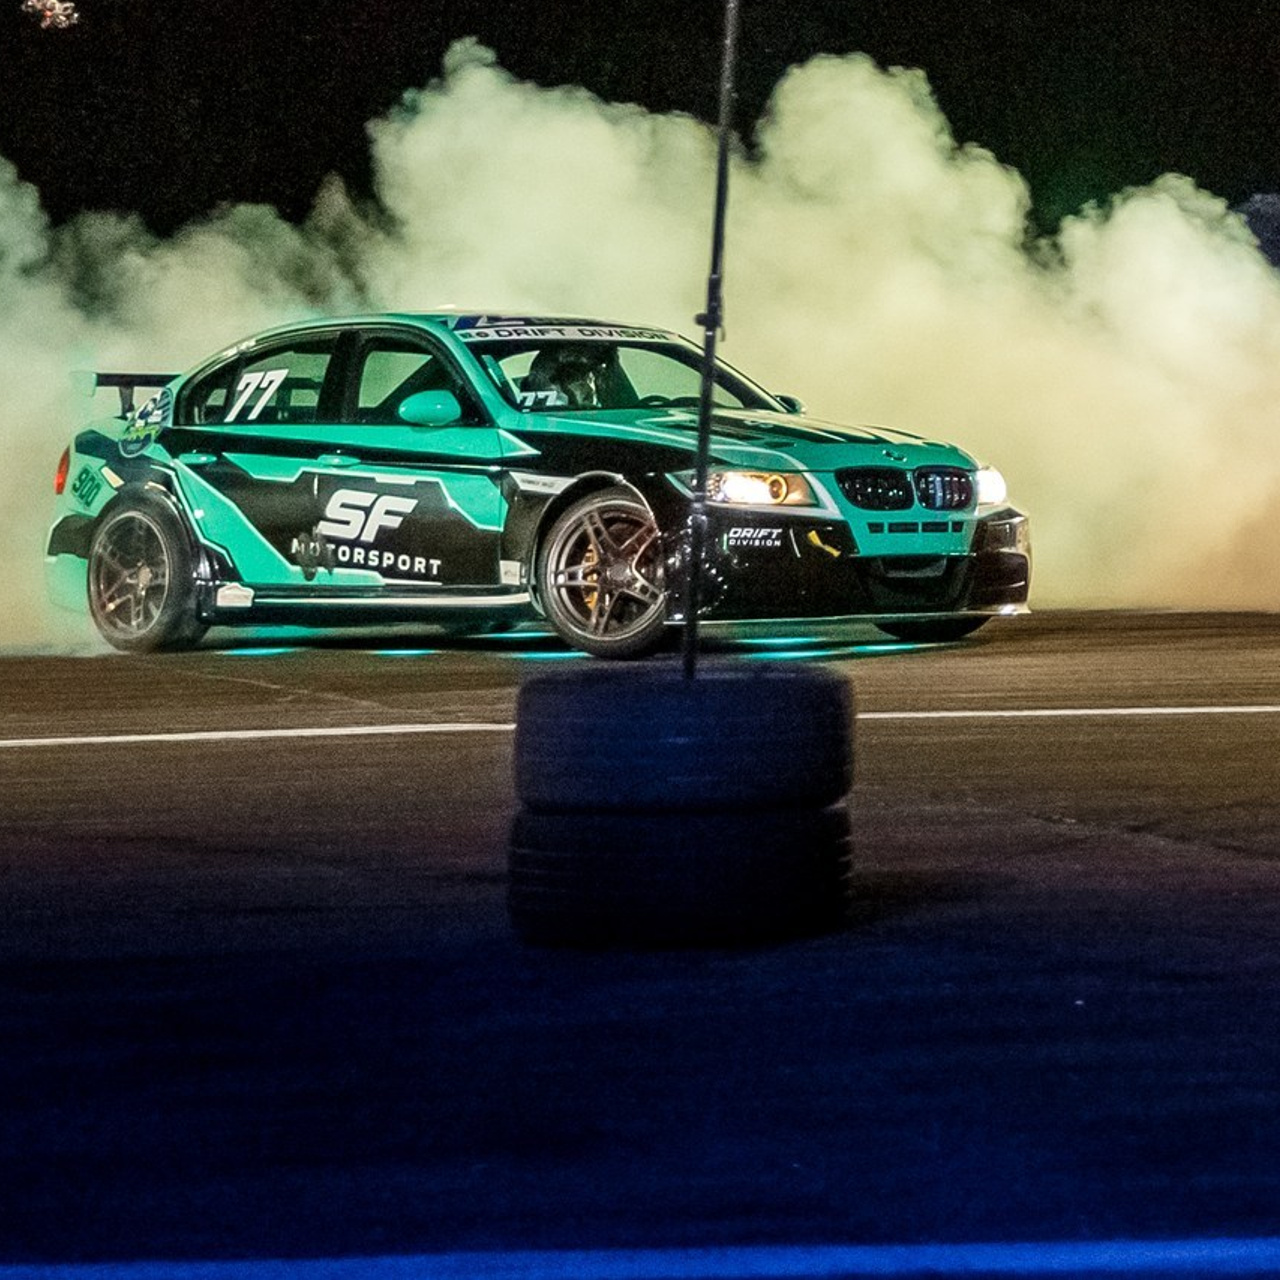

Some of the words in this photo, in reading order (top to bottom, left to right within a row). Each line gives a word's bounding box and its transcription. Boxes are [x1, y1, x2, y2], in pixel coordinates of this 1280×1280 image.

[494, 328, 566, 338] DRIFT
[578, 328, 670, 341] DIVISION
[223, 369, 289, 422] 77
[519, 391, 557, 406] 77
[317, 488, 418, 543] SF
[728, 528, 782, 539] DRIFT
[728, 539, 781, 547] DIVISION
